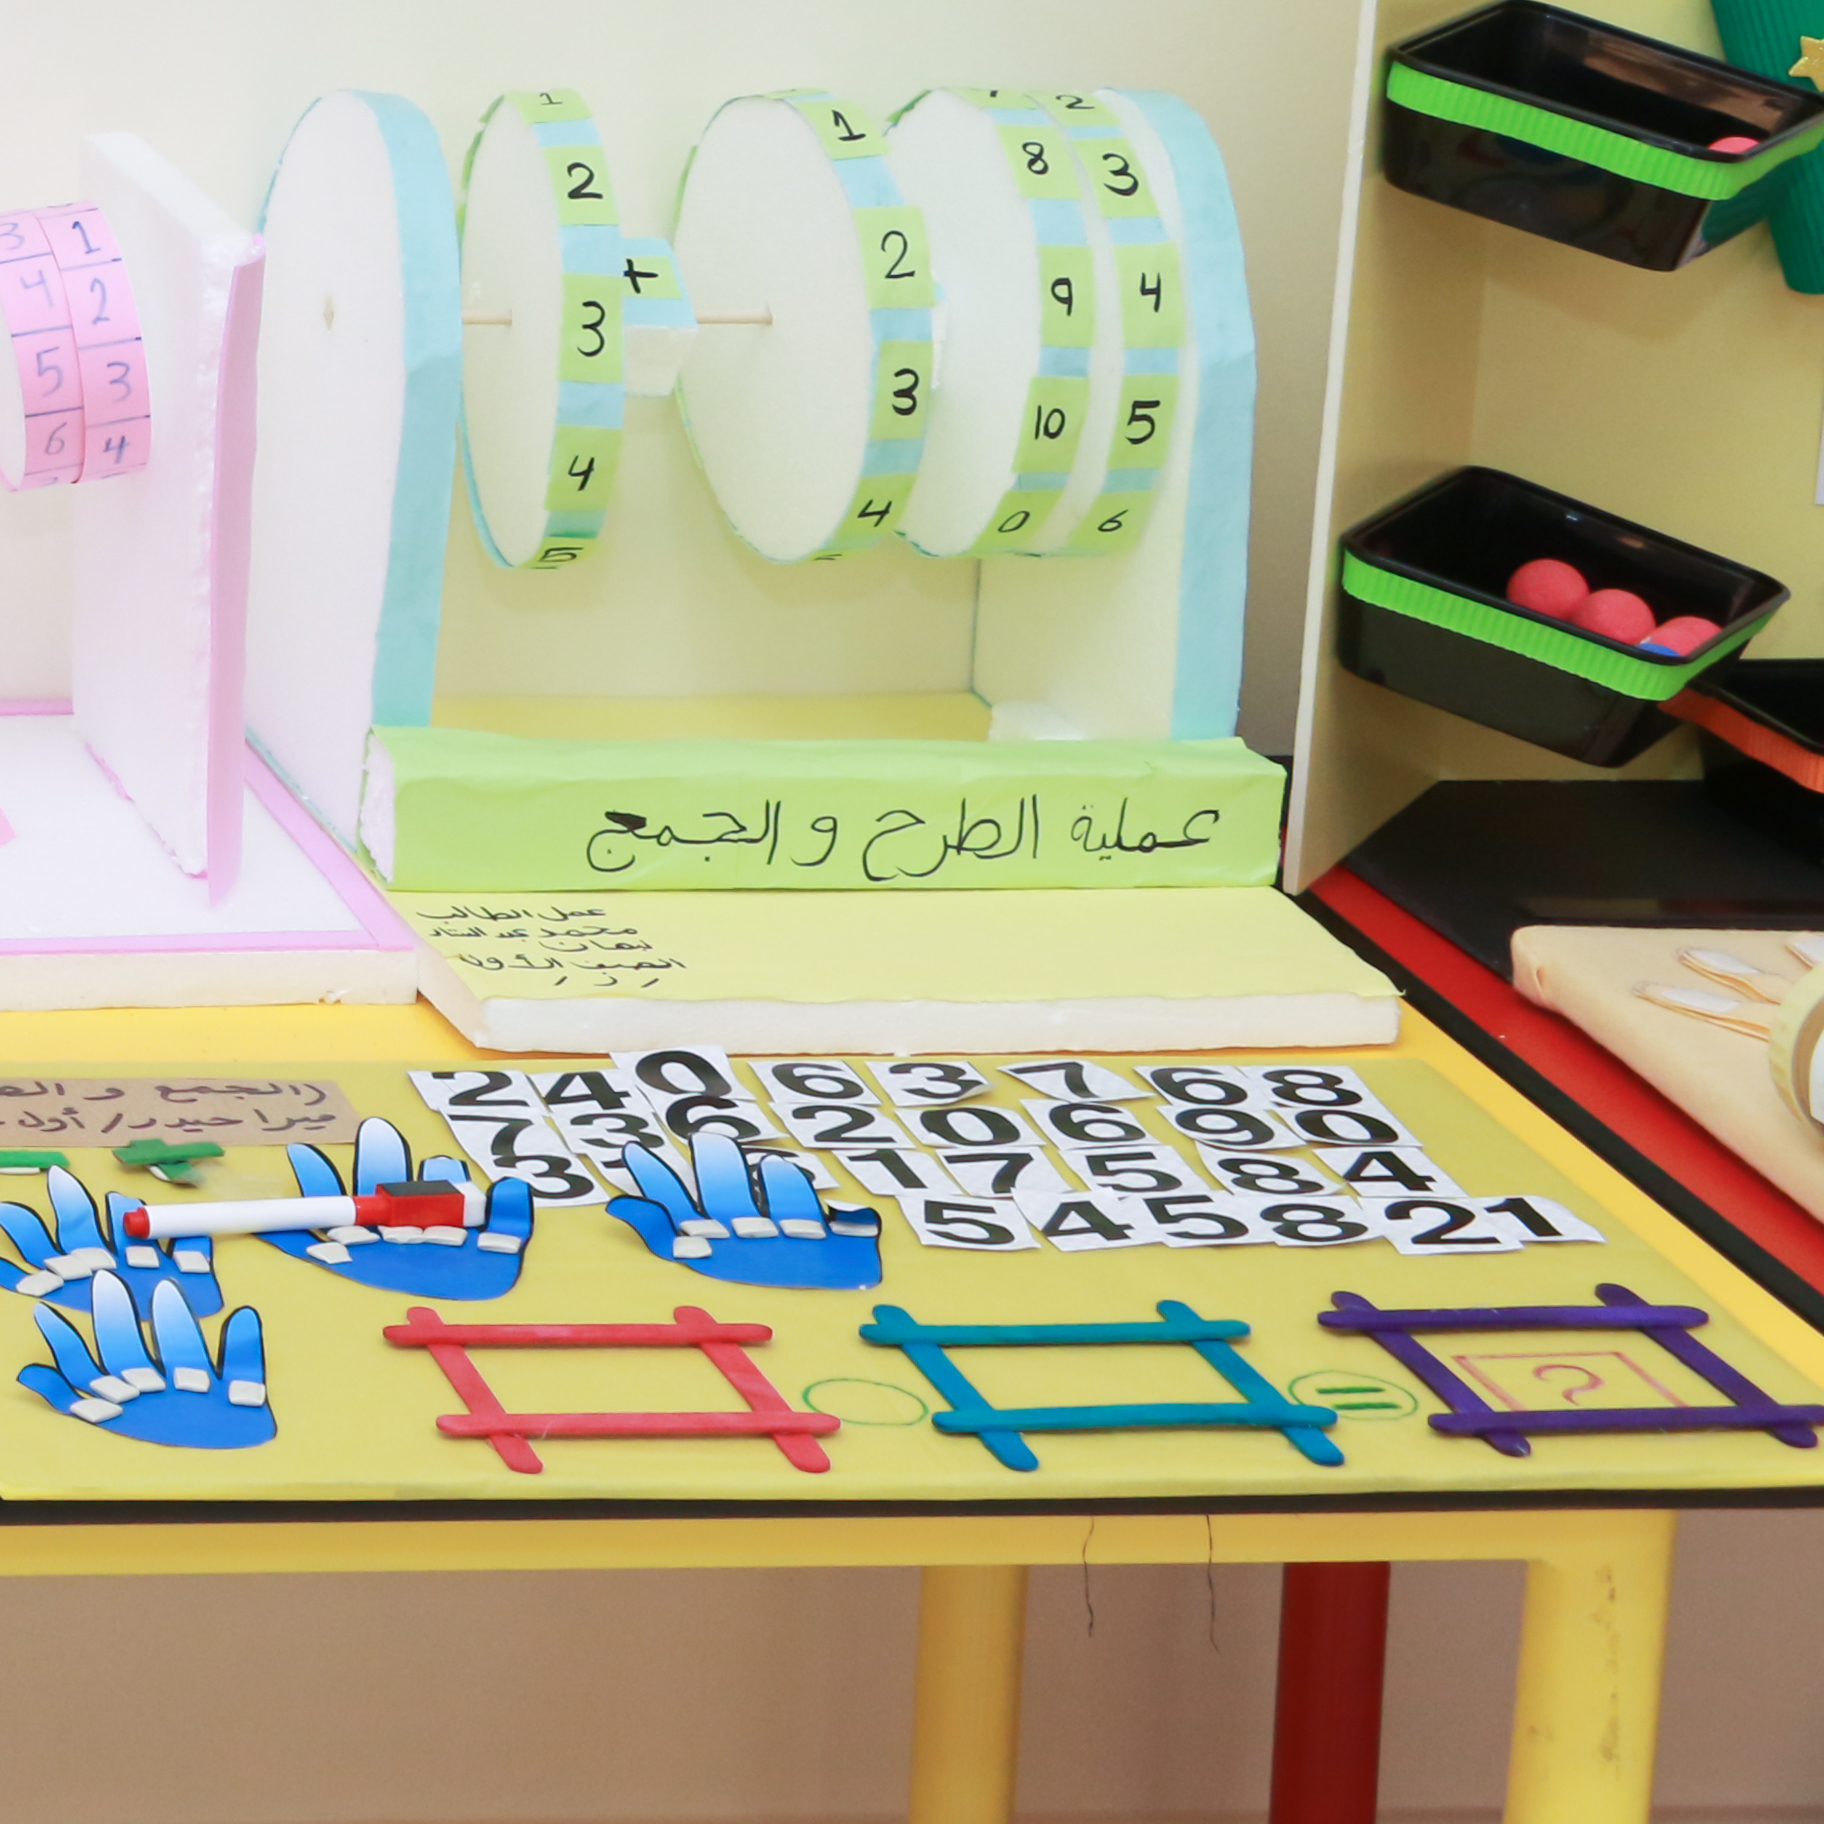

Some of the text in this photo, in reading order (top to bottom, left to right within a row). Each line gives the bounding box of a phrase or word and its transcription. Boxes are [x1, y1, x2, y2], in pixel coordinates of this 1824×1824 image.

[568, 163, 603, 200] 2
[1103, 153, 1140, 195] 3
[882, 231, 915, 279] 2
[577, 300, 606, 357] 3
[587, 793, 1219, 881] عملية الطرح و الجمع
[635, 1051, 731, 1099] 0
[771, 1063, 865, 1099] 6
[888, 1062, 979, 1099] 3
[1007, 1061, 1101, 1099] 7
[1261, 1069, 1362, 1106] 8
[1384, 1200, 1502, 1245] 2
[1484, 1197, 1564, 1237] 1
